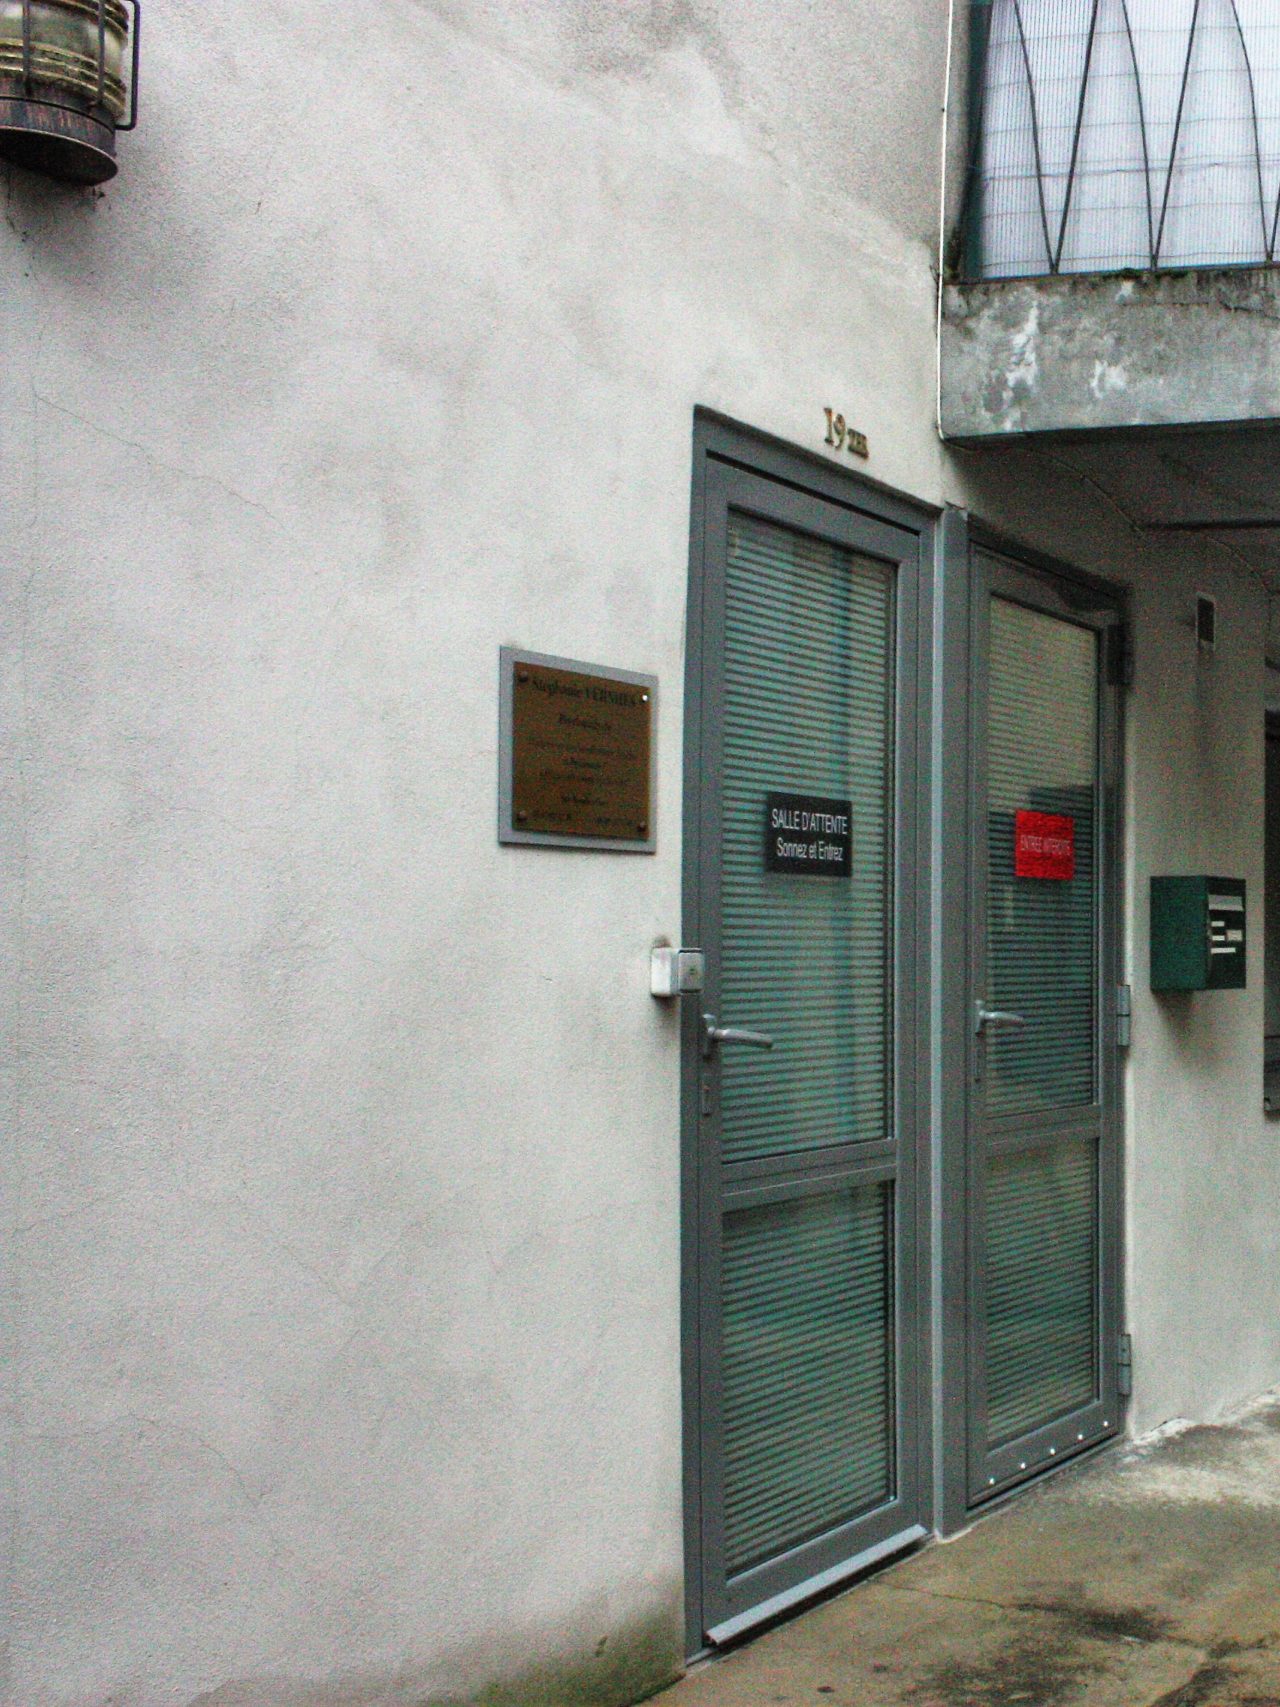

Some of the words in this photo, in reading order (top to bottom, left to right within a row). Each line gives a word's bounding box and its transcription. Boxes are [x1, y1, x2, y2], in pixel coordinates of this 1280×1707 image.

[772, 808, 800, 830] SALLE
[801, 811, 848, 835] D'ATTENTE
[776, 837, 807, 858] Sonnez
[809, 841, 817, 859] et
[818, 841, 843, 861] Entrez
